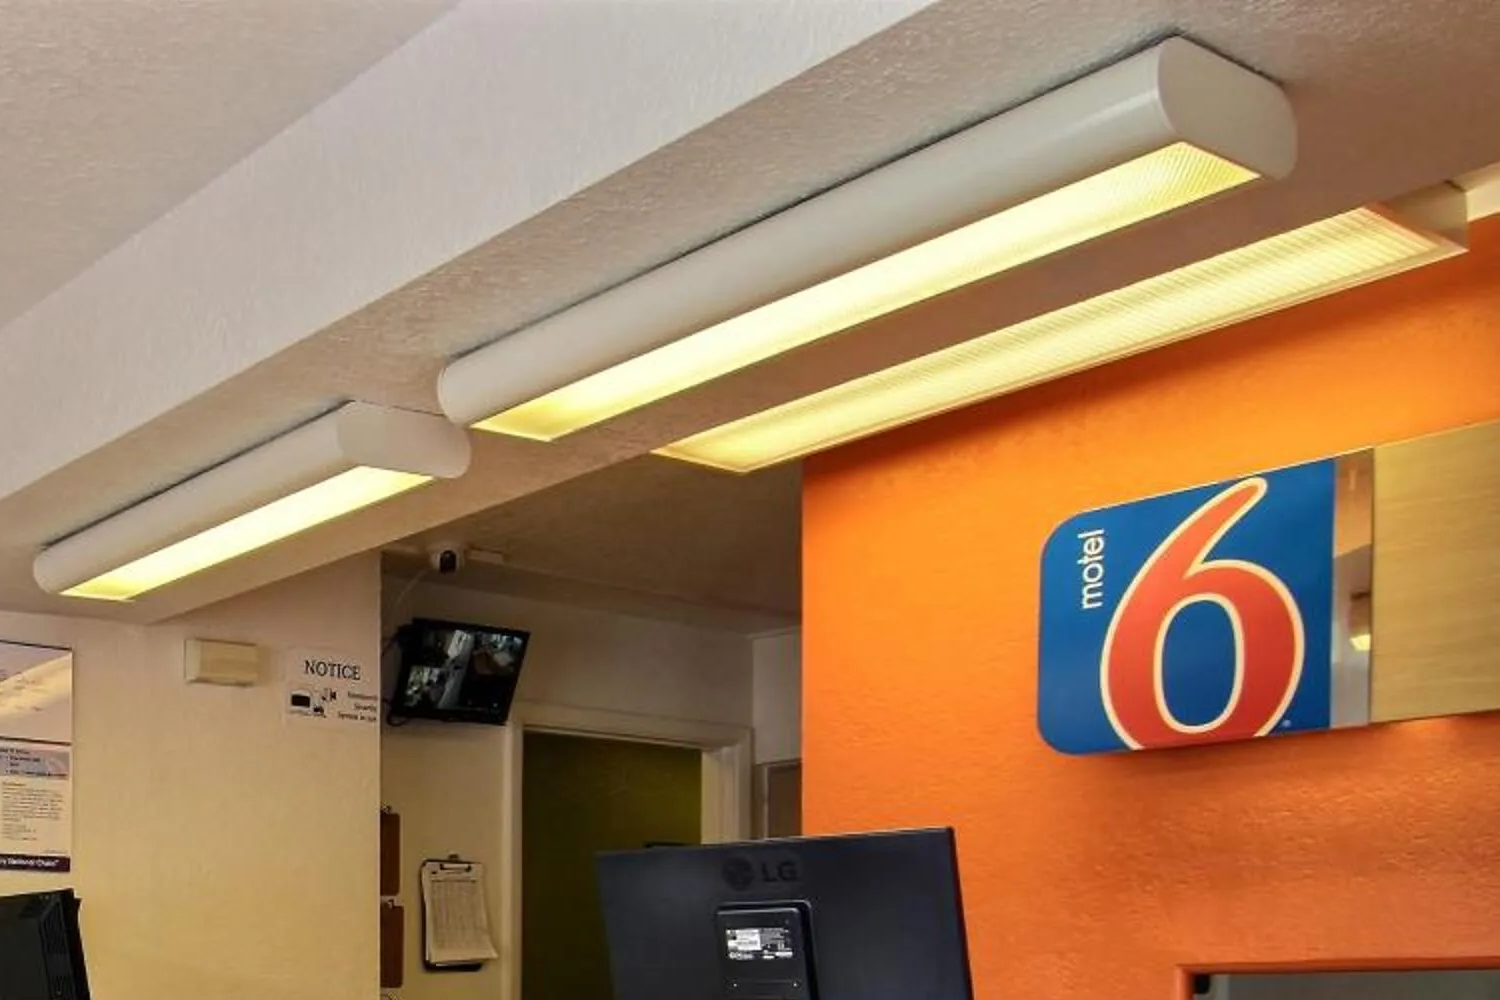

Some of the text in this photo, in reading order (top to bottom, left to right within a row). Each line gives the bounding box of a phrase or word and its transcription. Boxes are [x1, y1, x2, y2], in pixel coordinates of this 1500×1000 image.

[1077, 476, 1305, 751] motel 6
[304, 659, 361, 681] NOTICE
[762, 861, 798, 882] LG
